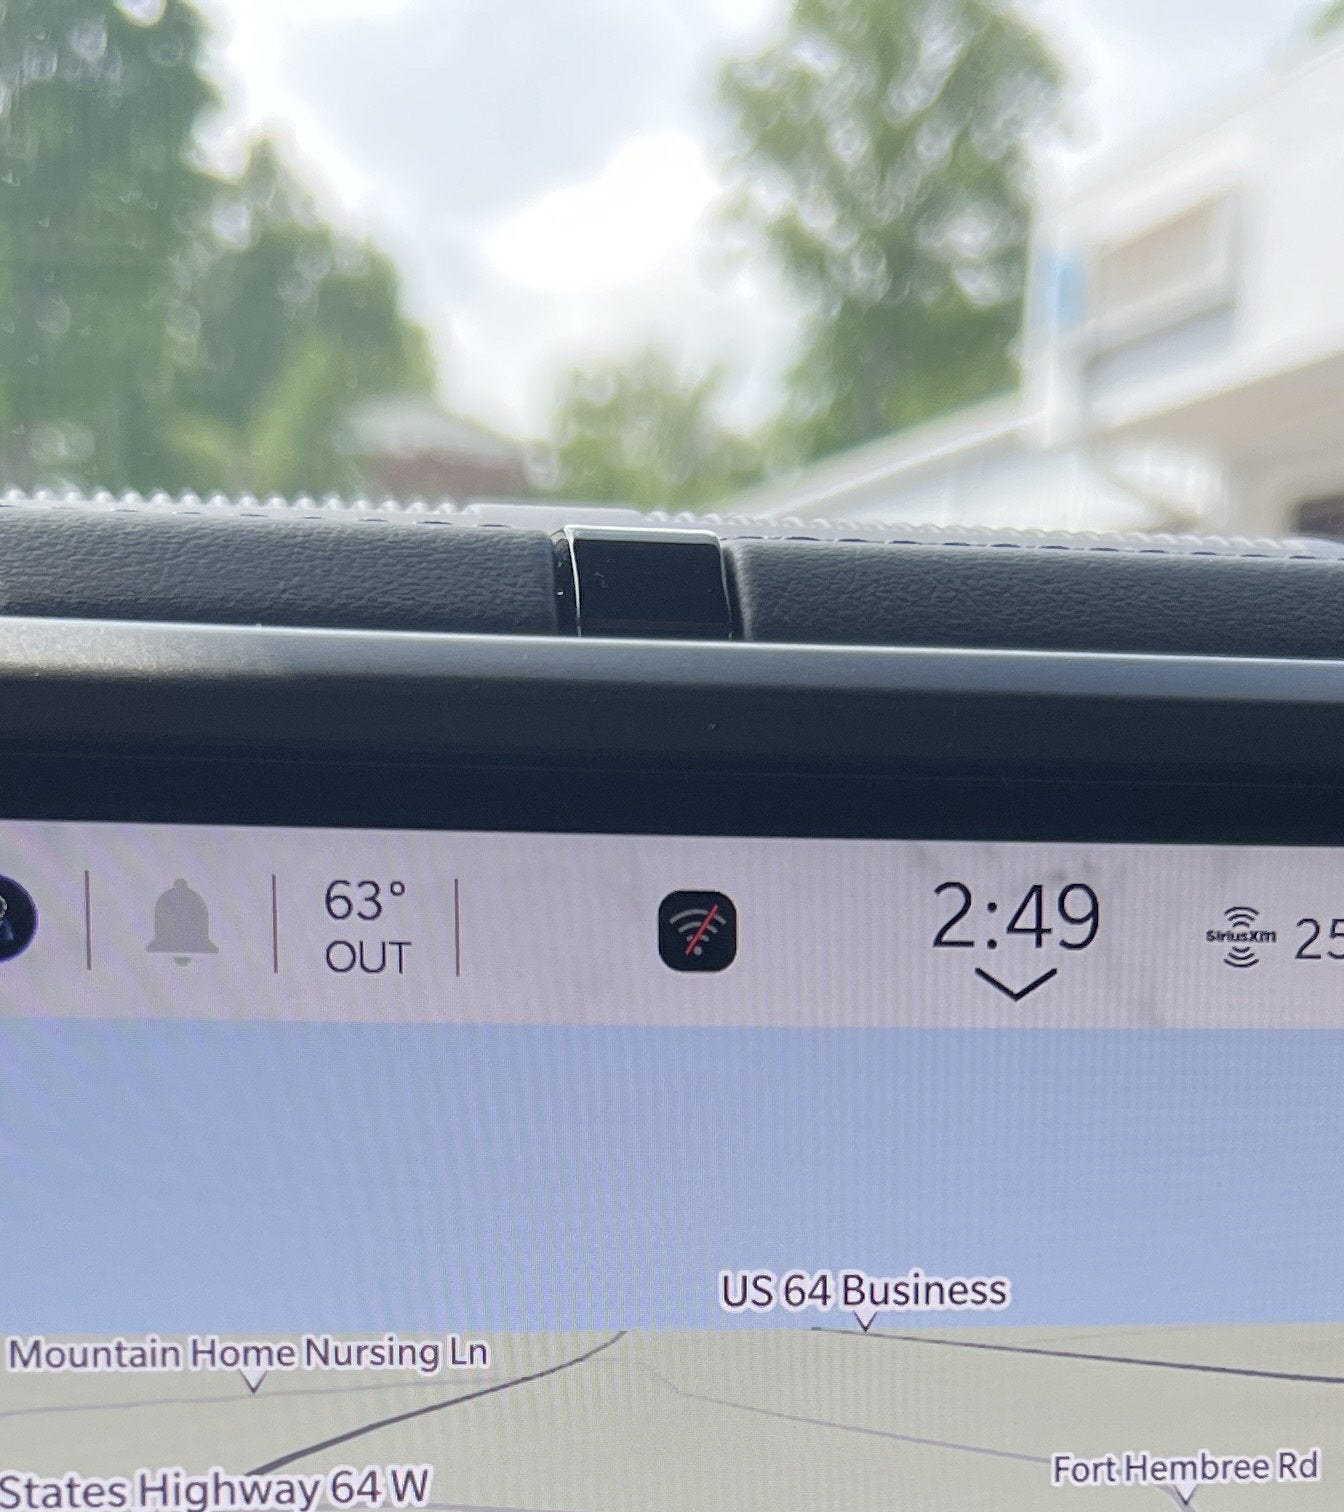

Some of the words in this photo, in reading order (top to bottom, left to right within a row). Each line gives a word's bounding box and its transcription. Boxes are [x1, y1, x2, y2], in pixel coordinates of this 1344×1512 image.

[931, 880, 1102, 951] 2:49
[324, 940, 413, 975] OUT
[720, 1273, 774, 1308] US
[781, 1273, 832, 1308] 64
[841, 1273, 1009, 1308] Business
[7, 1336, 182, 1372] Mountain
[189, 1336, 297, 1371] Home
[304, 1336, 440, 1374] Nursing
[448, 1336, 490, 1368] Ln
[1053, 1454, 1118, 1486] Fort
[1124, 1452, 1270, 1483] Hembree
[1277, 1451, 1319, 1480] Rd
[328, 1470, 383, 1506] 64
[388, 1468, 431, 1504] W
